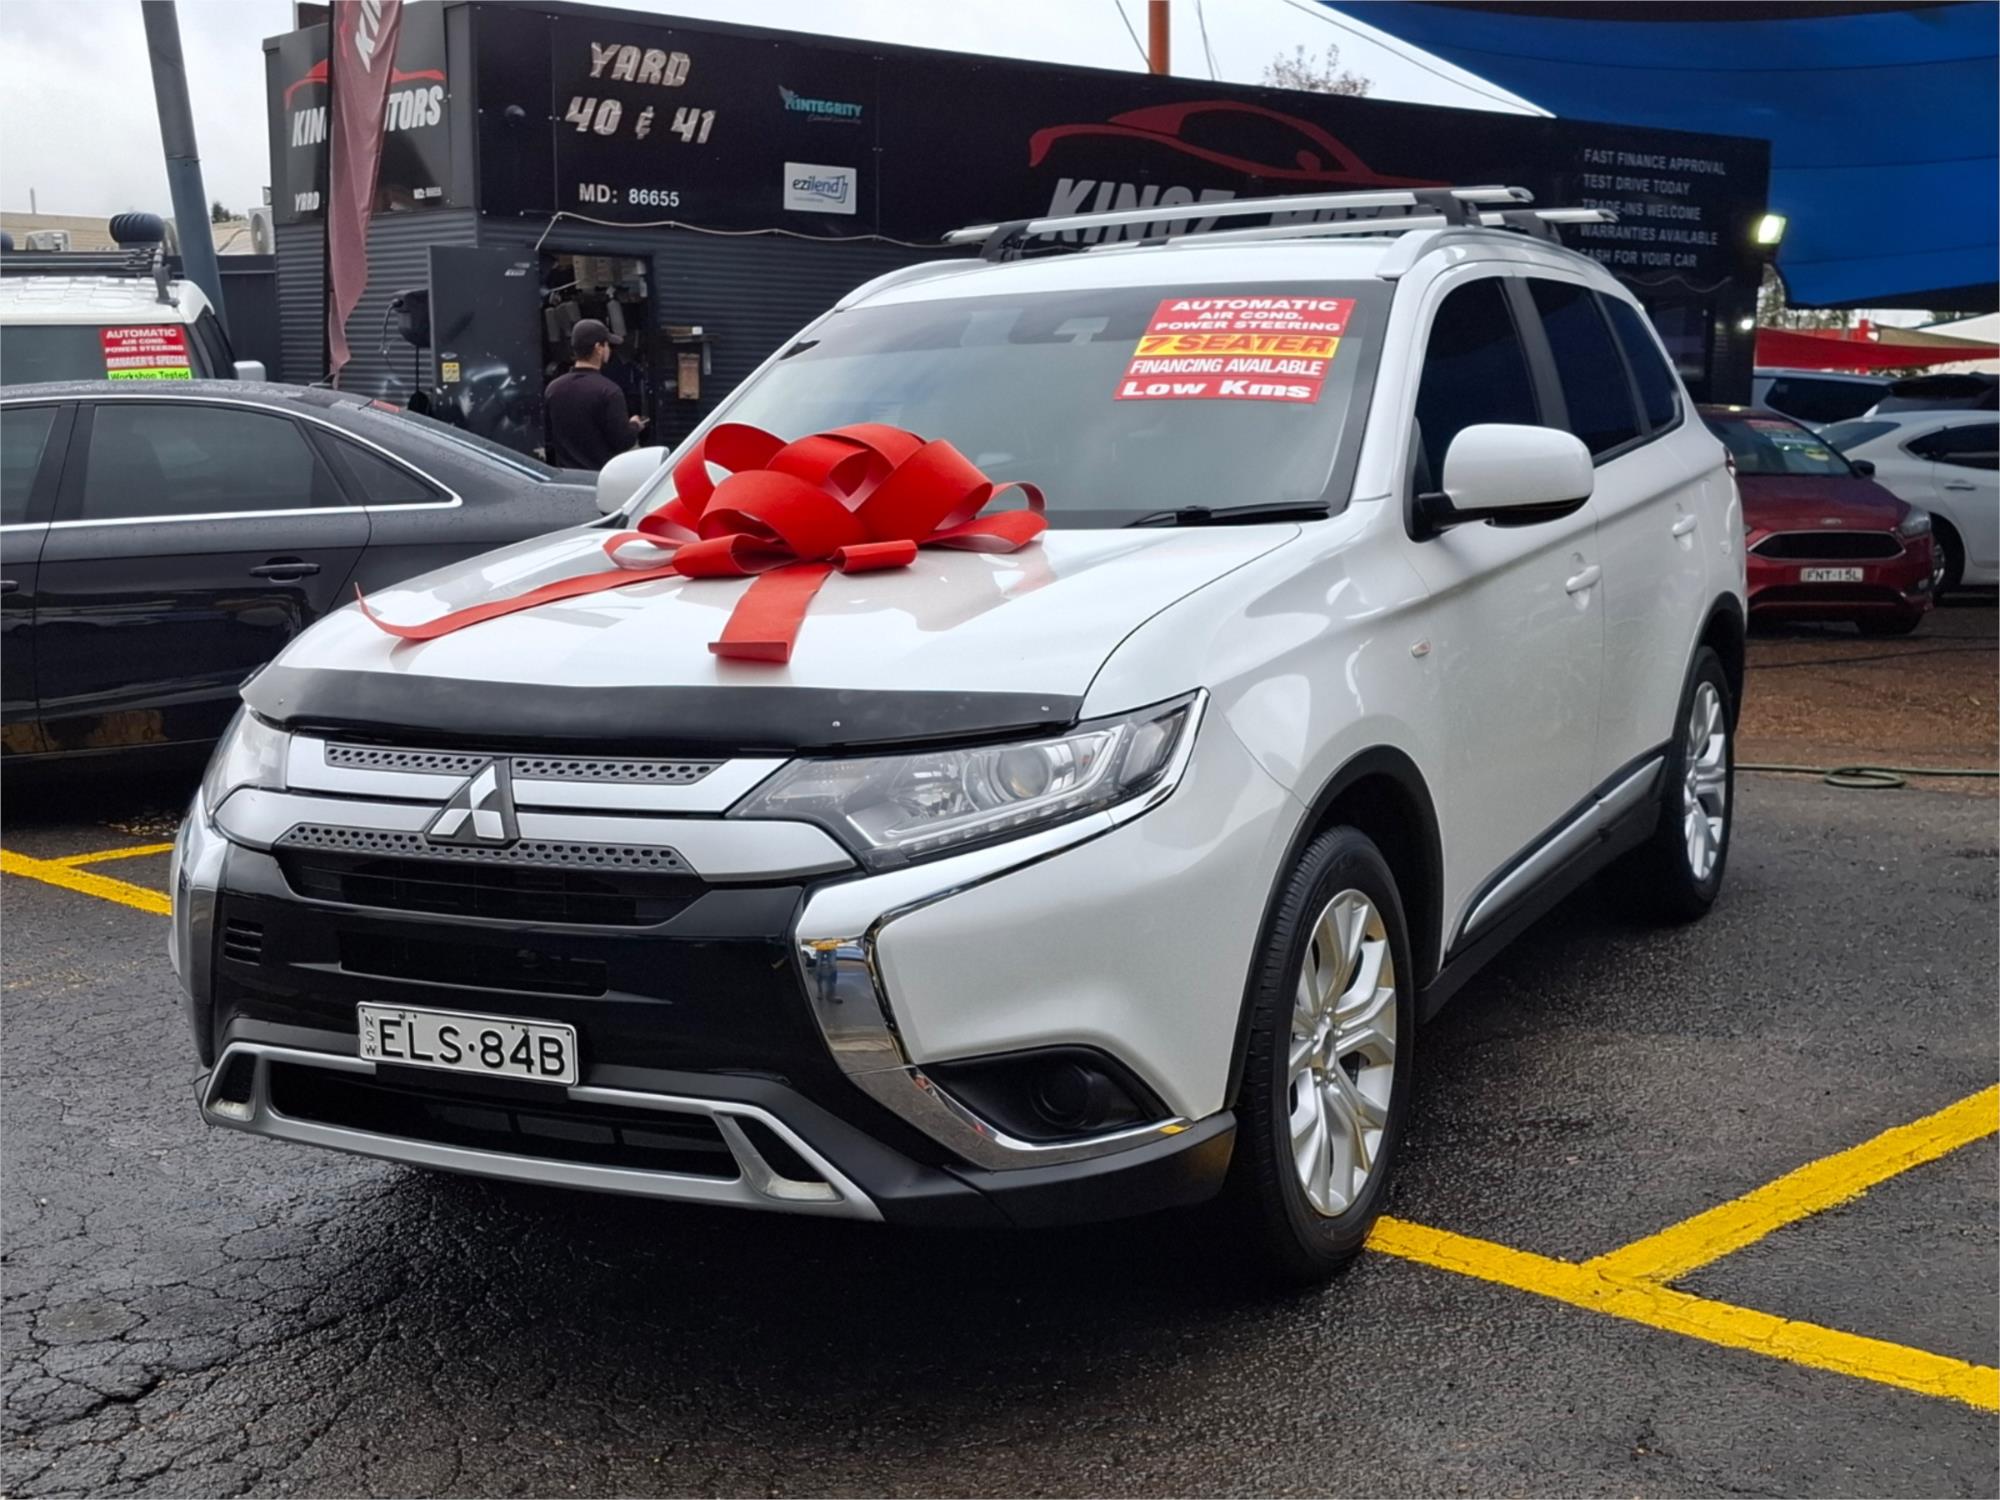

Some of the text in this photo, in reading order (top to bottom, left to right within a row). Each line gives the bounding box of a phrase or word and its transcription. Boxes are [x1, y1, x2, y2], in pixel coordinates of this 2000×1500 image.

[590, 42, 691, 87] YARD
[797, 96, 862, 117] INTEGRITY
[292, 85, 444, 147] KIN TORS
[565, 97, 716, 144] 40 & 41
[1584, 149, 1726, 175] FAST FINANCE APPROVAL
[792, 175, 841, 194] ezilend
[1583, 174, 1691, 195] TEST DRIVE TODAY
[294, 191, 320, 212] YARD
[579, 183, 680, 207] MD: 86655
[1646, 204, 1701, 220] WELCOME
[1581, 224, 1718, 245] WARRANTIES AVAILABLE
[1614, 250, 1638, 264] FOR
[1641, 252, 1671, 266] YOUR
[1674, 254, 1697, 267] CAR
[1171, 299, 1338, 311] AUTOMATIC
[1198, 311, 1303, 320] AIR COND.
[106, 328, 177, 339] AUTOMATIC
[1155, 320, 1340, 331] POWER STEERING
[105, 344, 184, 354] POWER STEERING
[121, 338, 137, 346] AIR
[1139, 335, 1335, 354] 7 SEATER
[159, 370, 189, 380] Tested
[1130, 358, 1324, 375] FINANCING AVAILABLE
[1122, 380, 1311, 398] Low Kms
